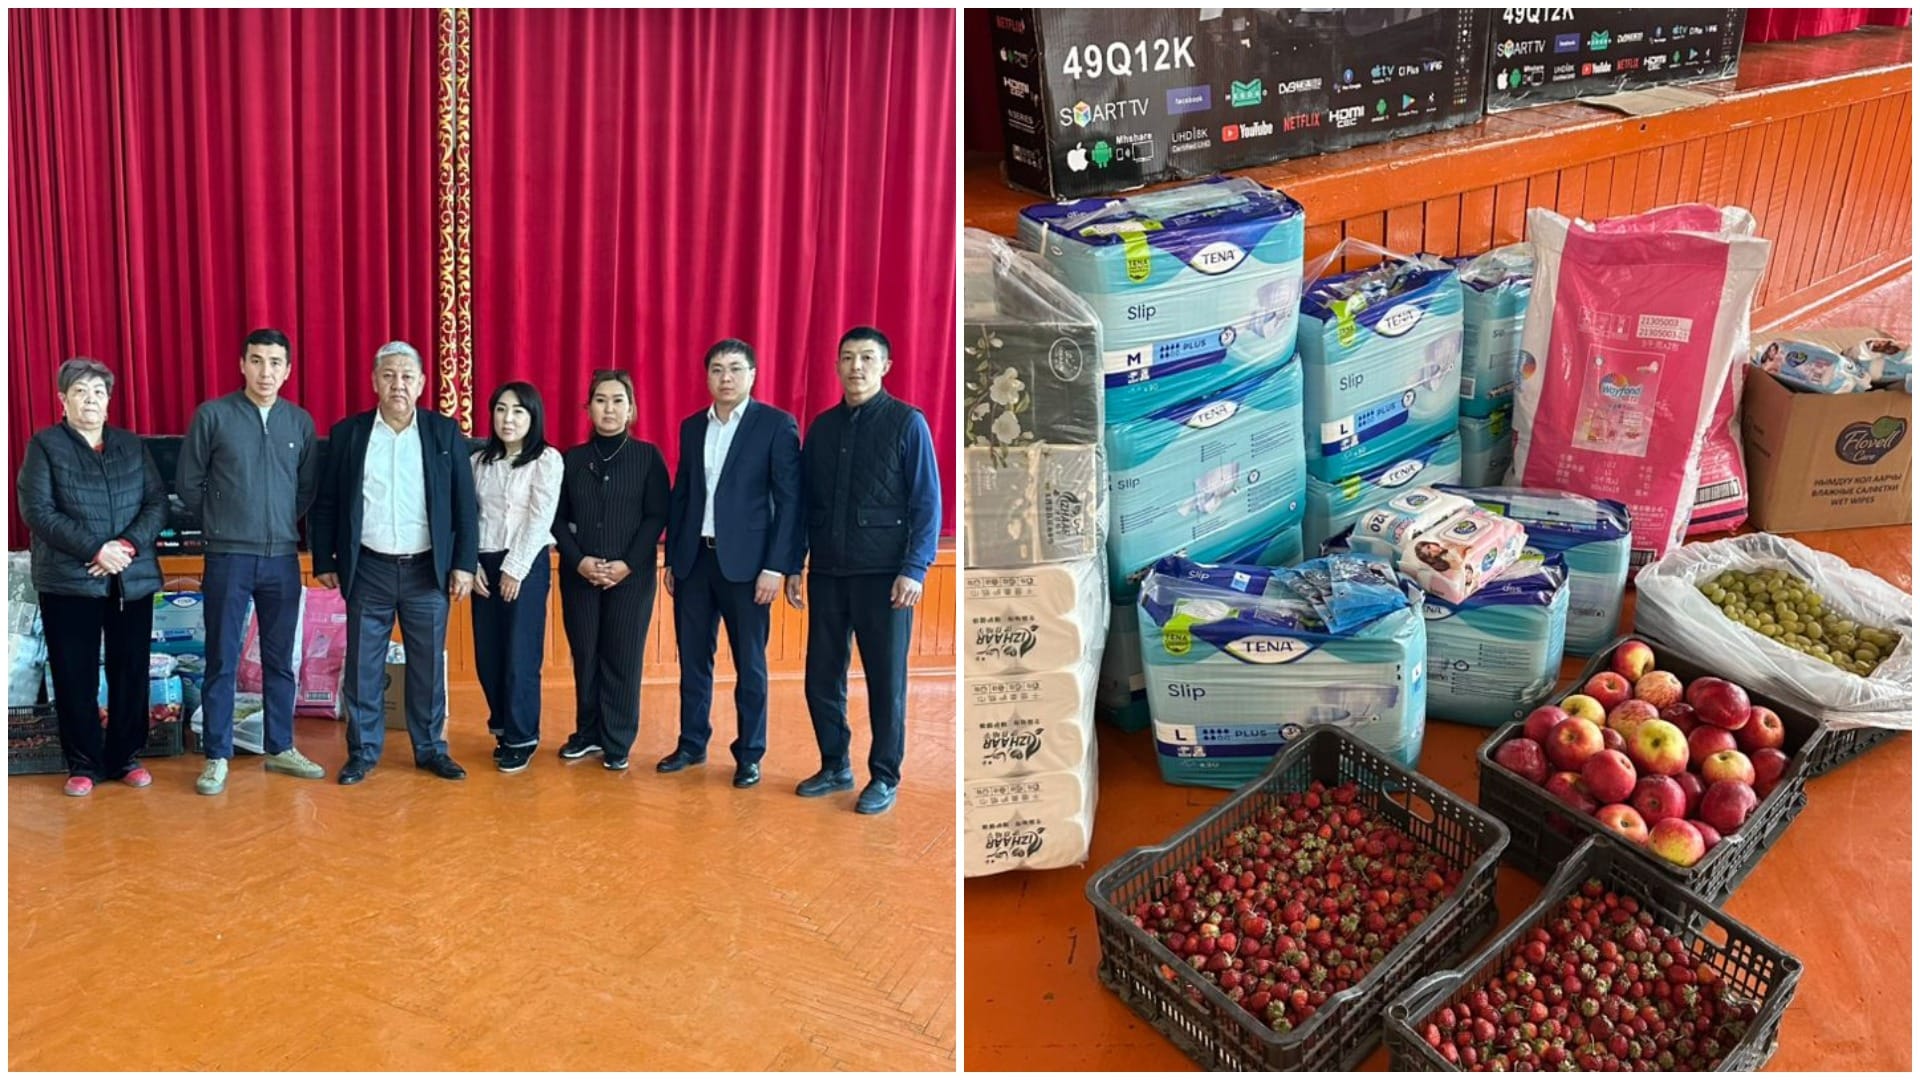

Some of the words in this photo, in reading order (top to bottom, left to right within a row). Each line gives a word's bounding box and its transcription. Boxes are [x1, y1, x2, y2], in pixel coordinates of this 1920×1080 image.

[1063, 35, 1195, 79] 49Q12K
[1128, 98, 1149, 116] TV
[1240, 120, 1273, 138] YouTube
[1283, 112, 1320, 132] NETFLIX
[1116, 133, 1152, 144] Mhshare
[1202, 249, 1237, 265] TENA
[1127, 303, 1157, 321] Slip
[1387, 309, 1415, 328] TENA
[1641, 316, 1679, 327] 21305003
[1182, 339, 1206, 350] PLUS
[1127, 353, 1141, 366] M
[1339, 373, 1364, 391] Slip
[1198, 404, 1228, 423] TENA
[1340, 424, 1348, 435] L
[1843, 430, 1901, 451] Flovell
[1117, 478, 1140, 490] Slip
[1811, 487, 1853, 497] ВЛАЖНЫЕ
[1856, 484, 1899, 494] САЛФЕТКИ
[1831, 497, 1849, 506] WET
[1851, 496, 1875, 504] WIPES
[976, 632, 1026, 645] IZHAAR
[1244, 641, 1294, 653] TENA
[1168, 684, 1206, 700] Slip
[1175, 729, 1187, 741] L
[1235, 730, 1268, 738] PLUS
[983, 735, 1031, 749] IZHAAR
[986, 835, 1033, 849] IZHAAR
